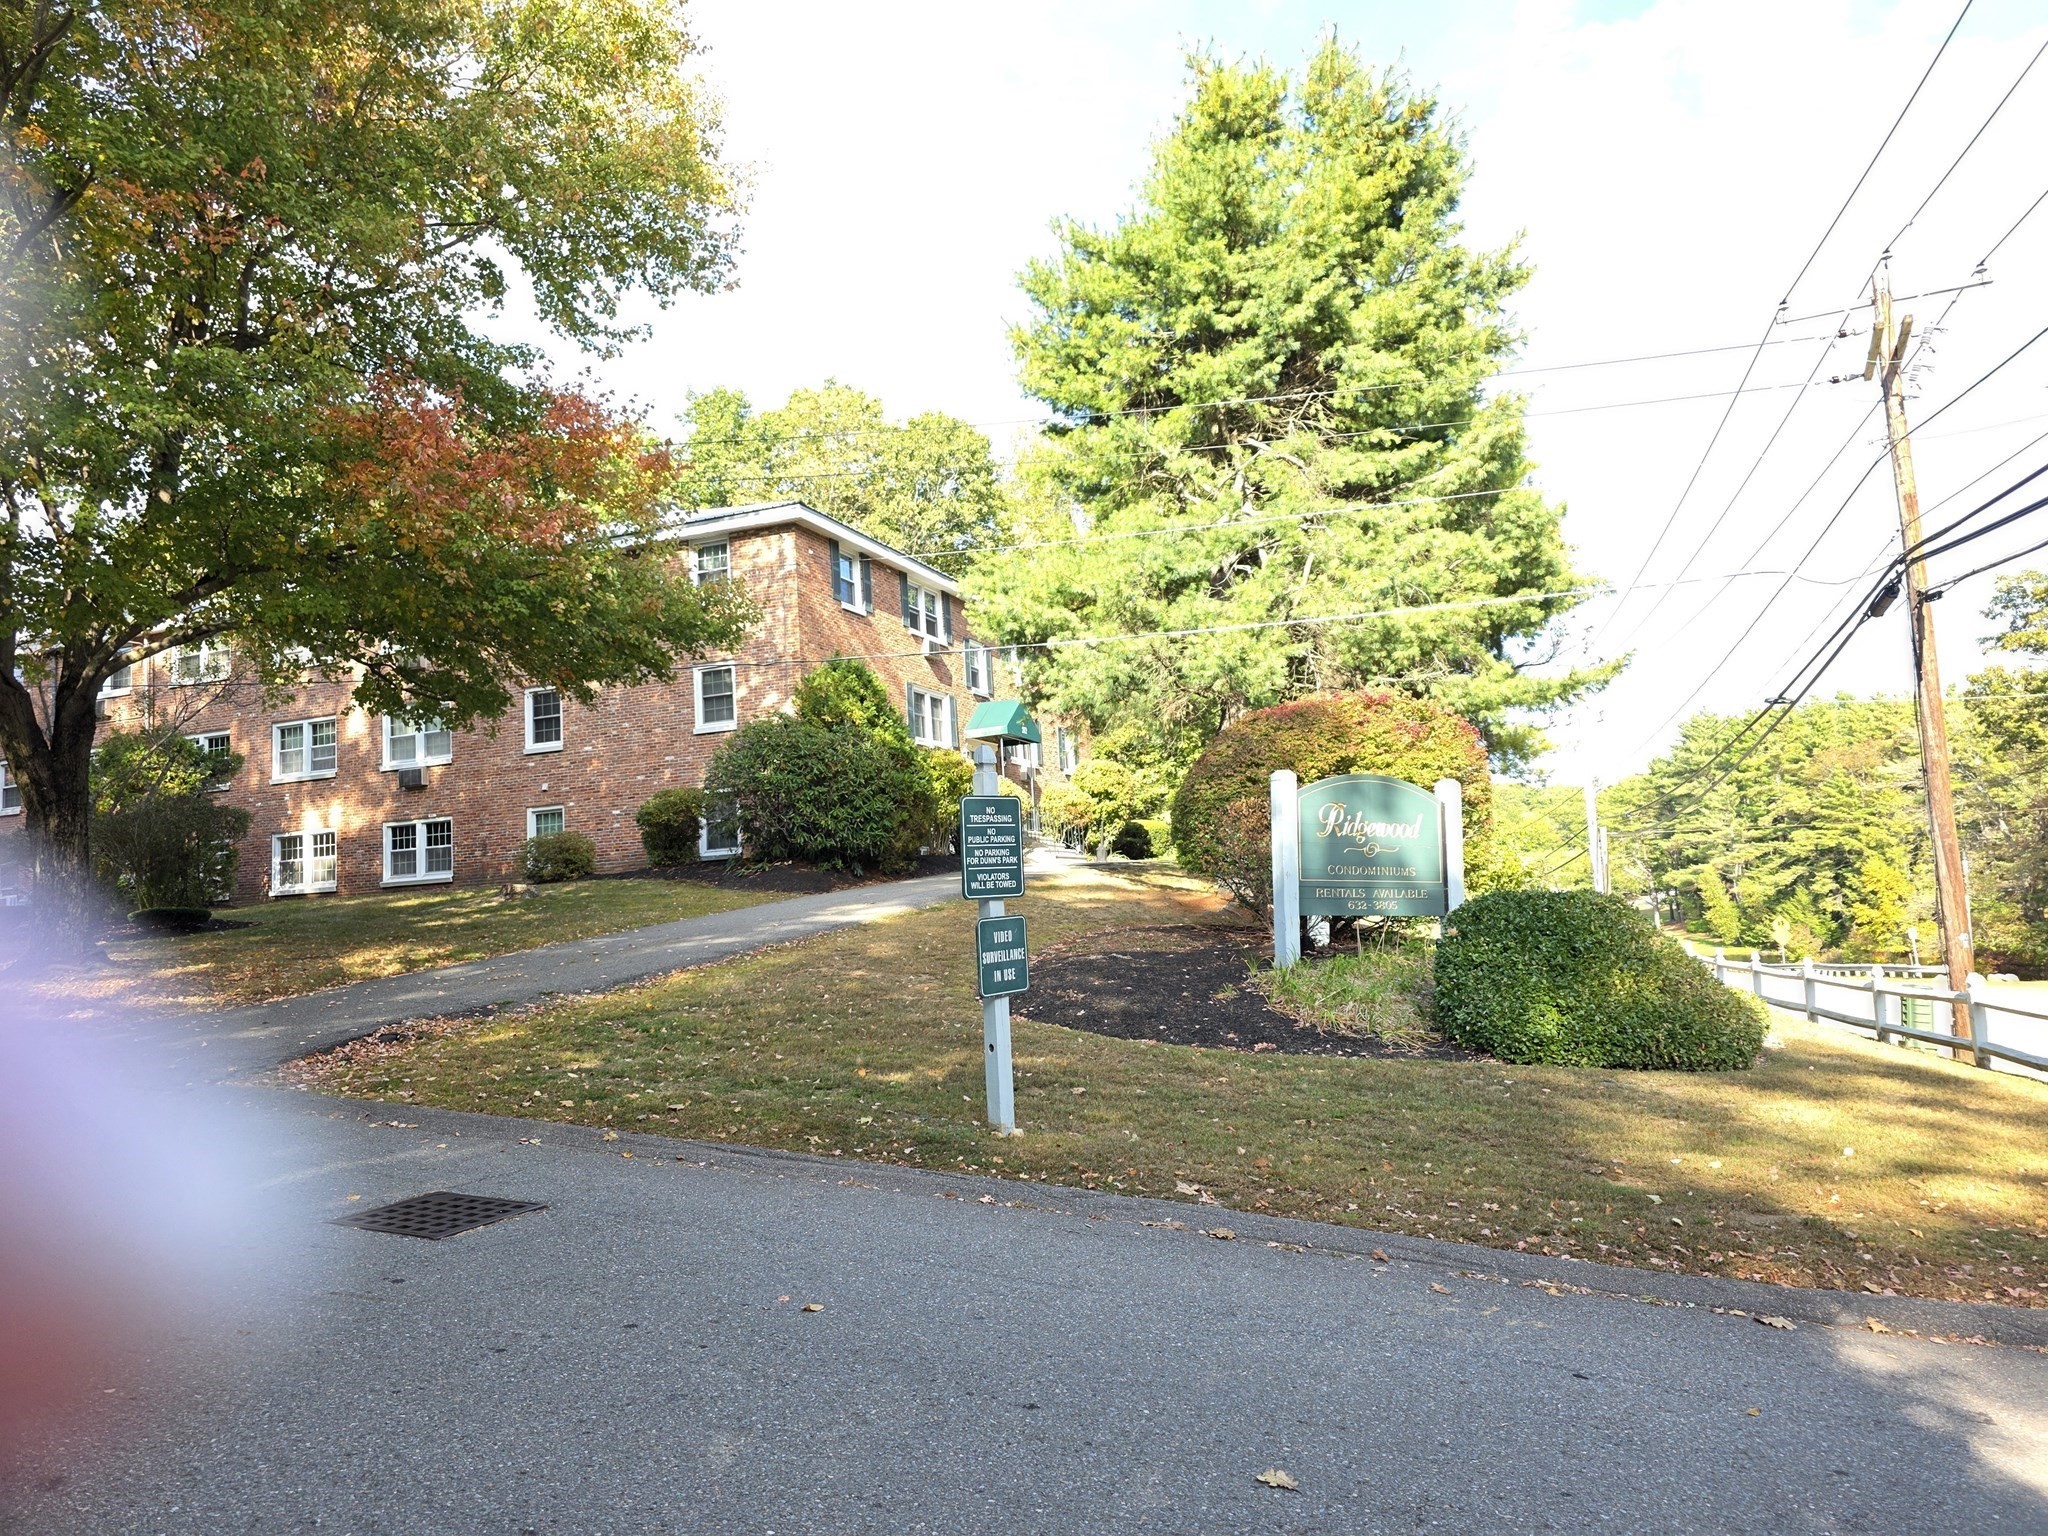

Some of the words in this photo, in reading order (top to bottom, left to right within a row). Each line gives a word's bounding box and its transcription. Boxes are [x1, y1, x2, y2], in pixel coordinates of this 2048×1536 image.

[986, 806, 995, 814] NO
[970, 814, 1012, 822] TRESPASSING
[1316, 802, 1424, 844] Ridgewood
[1327, 865, 1416, 876] CONDOMINIUMS
[977, 873, 1009, 881] VIOLATORS
[1316, 888, 1365, 898] RENTALS
[1372, 888, 1428, 899] AVAILABLE
[1348, 901, 1398, 910] 632-3805
[993, 930, 1012, 943] VIDEO
[982, 948, 1025, 964] SURVEILLANCE
[994, 970, 1001, 982] IN
[1004, 968, 1015, 981] USE
